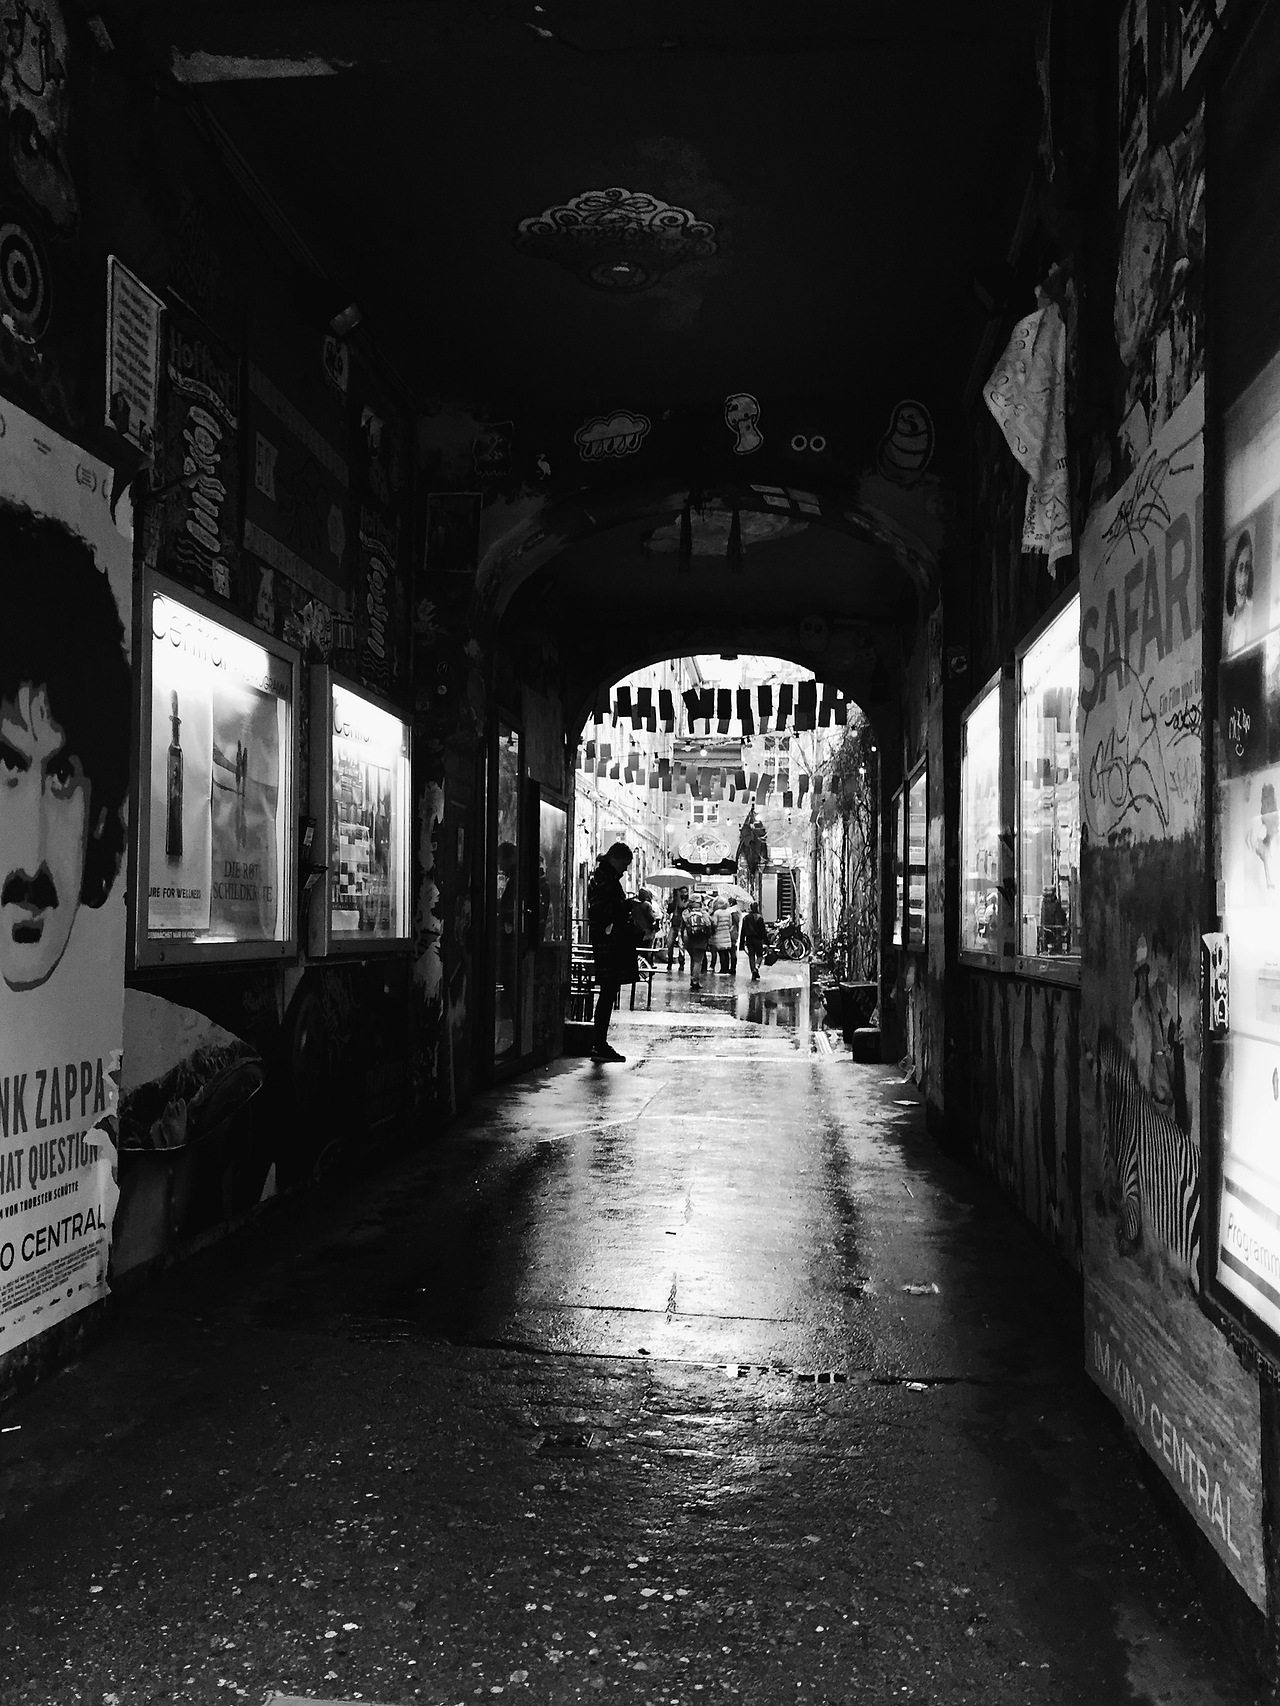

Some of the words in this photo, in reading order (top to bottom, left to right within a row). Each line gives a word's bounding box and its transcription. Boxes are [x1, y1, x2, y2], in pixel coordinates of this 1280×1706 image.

[1081, 490, 1203, 713] SAFARI
[162, 887, 175, 899] FOR
[213, 882, 273, 902] SCHILDKRTE
[223, 860, 241, 879] DIE
[242, 862, 263, 882] ROT
[36, 1058, 105, 1129] ZAPPA
[5, 1203, 19, 1218] VON
[20, 1190, 52, 1212] THORSTEN
[53, 1180, 79, 1200] SCHÜTTE
[21, 1204, 107, 1263] CENTRAL
[1094, 1330, 1111, 1381] IM
[1113, 1353, 1146, 1426] KINO
[1150, 1402, 1242, 1562] CENTRAL
